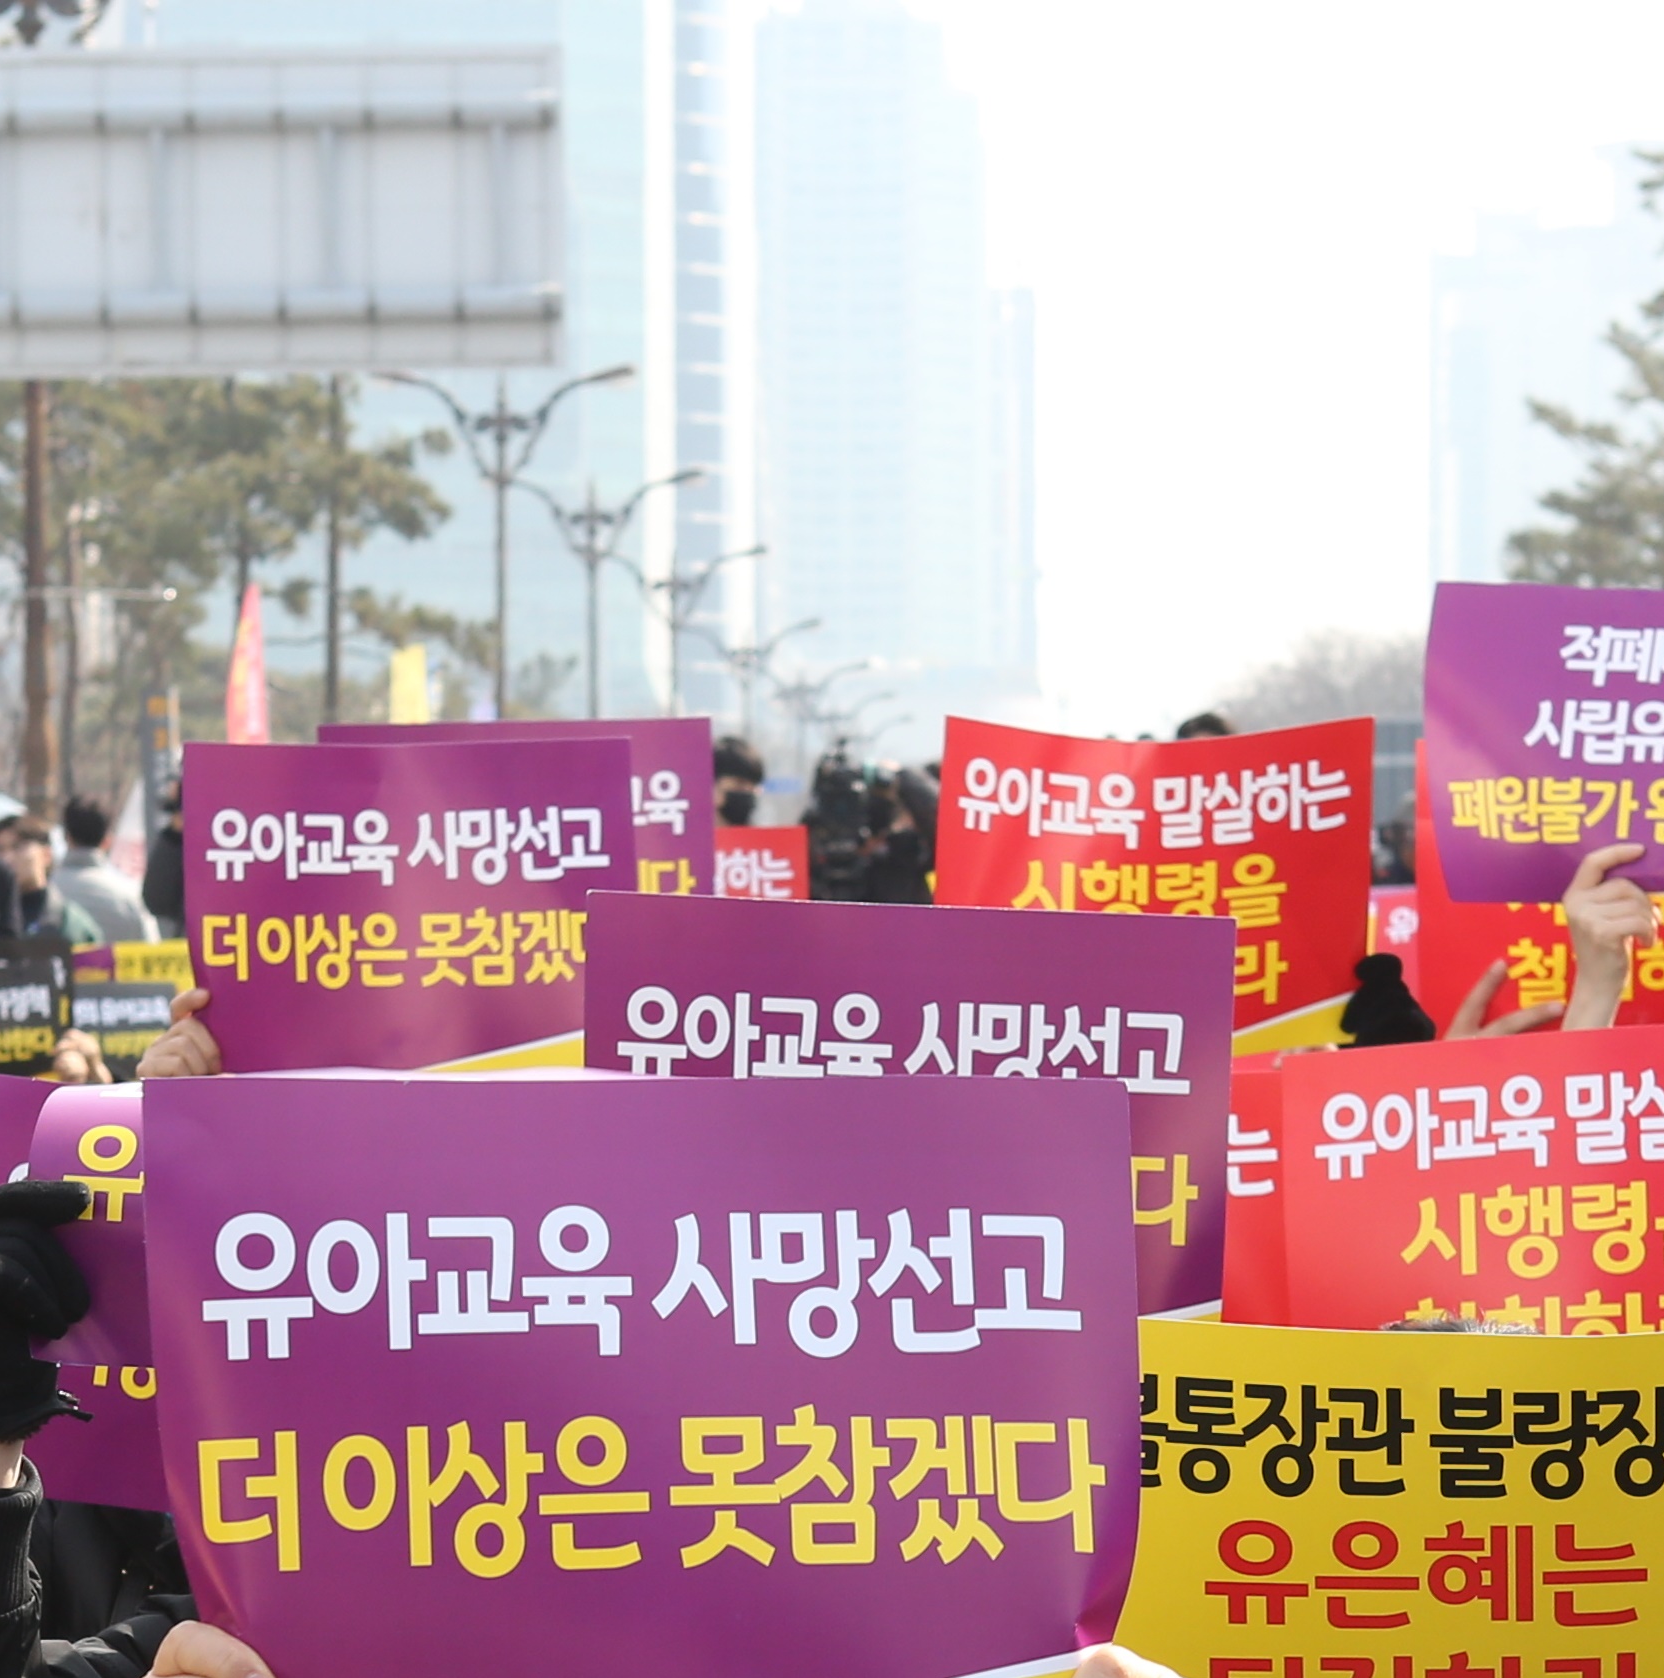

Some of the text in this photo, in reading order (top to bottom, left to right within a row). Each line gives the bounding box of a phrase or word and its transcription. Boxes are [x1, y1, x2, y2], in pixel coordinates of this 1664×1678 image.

[205, 809, 400, 886] 유아교육
[406, 806, 611, 886] 사망선고
[958, 757, 1352, 850] 유아교육 말살하는
[1447, 776, 1640, 845] 폐원불가
[202, 908, 587, 990] 더 이상은 못참겠
[616, 986, 1192, 1096] 유아교육 사망선고
[1314, 1075, 1556, 1181] 유아교육
[201, 1204, 1085, 1363] 유아교육 사망선고
[199, 1402, 1108, 1579] 더 이상은 못참겠다
[1204, 1518, 1649, 1629] 유은혜는
